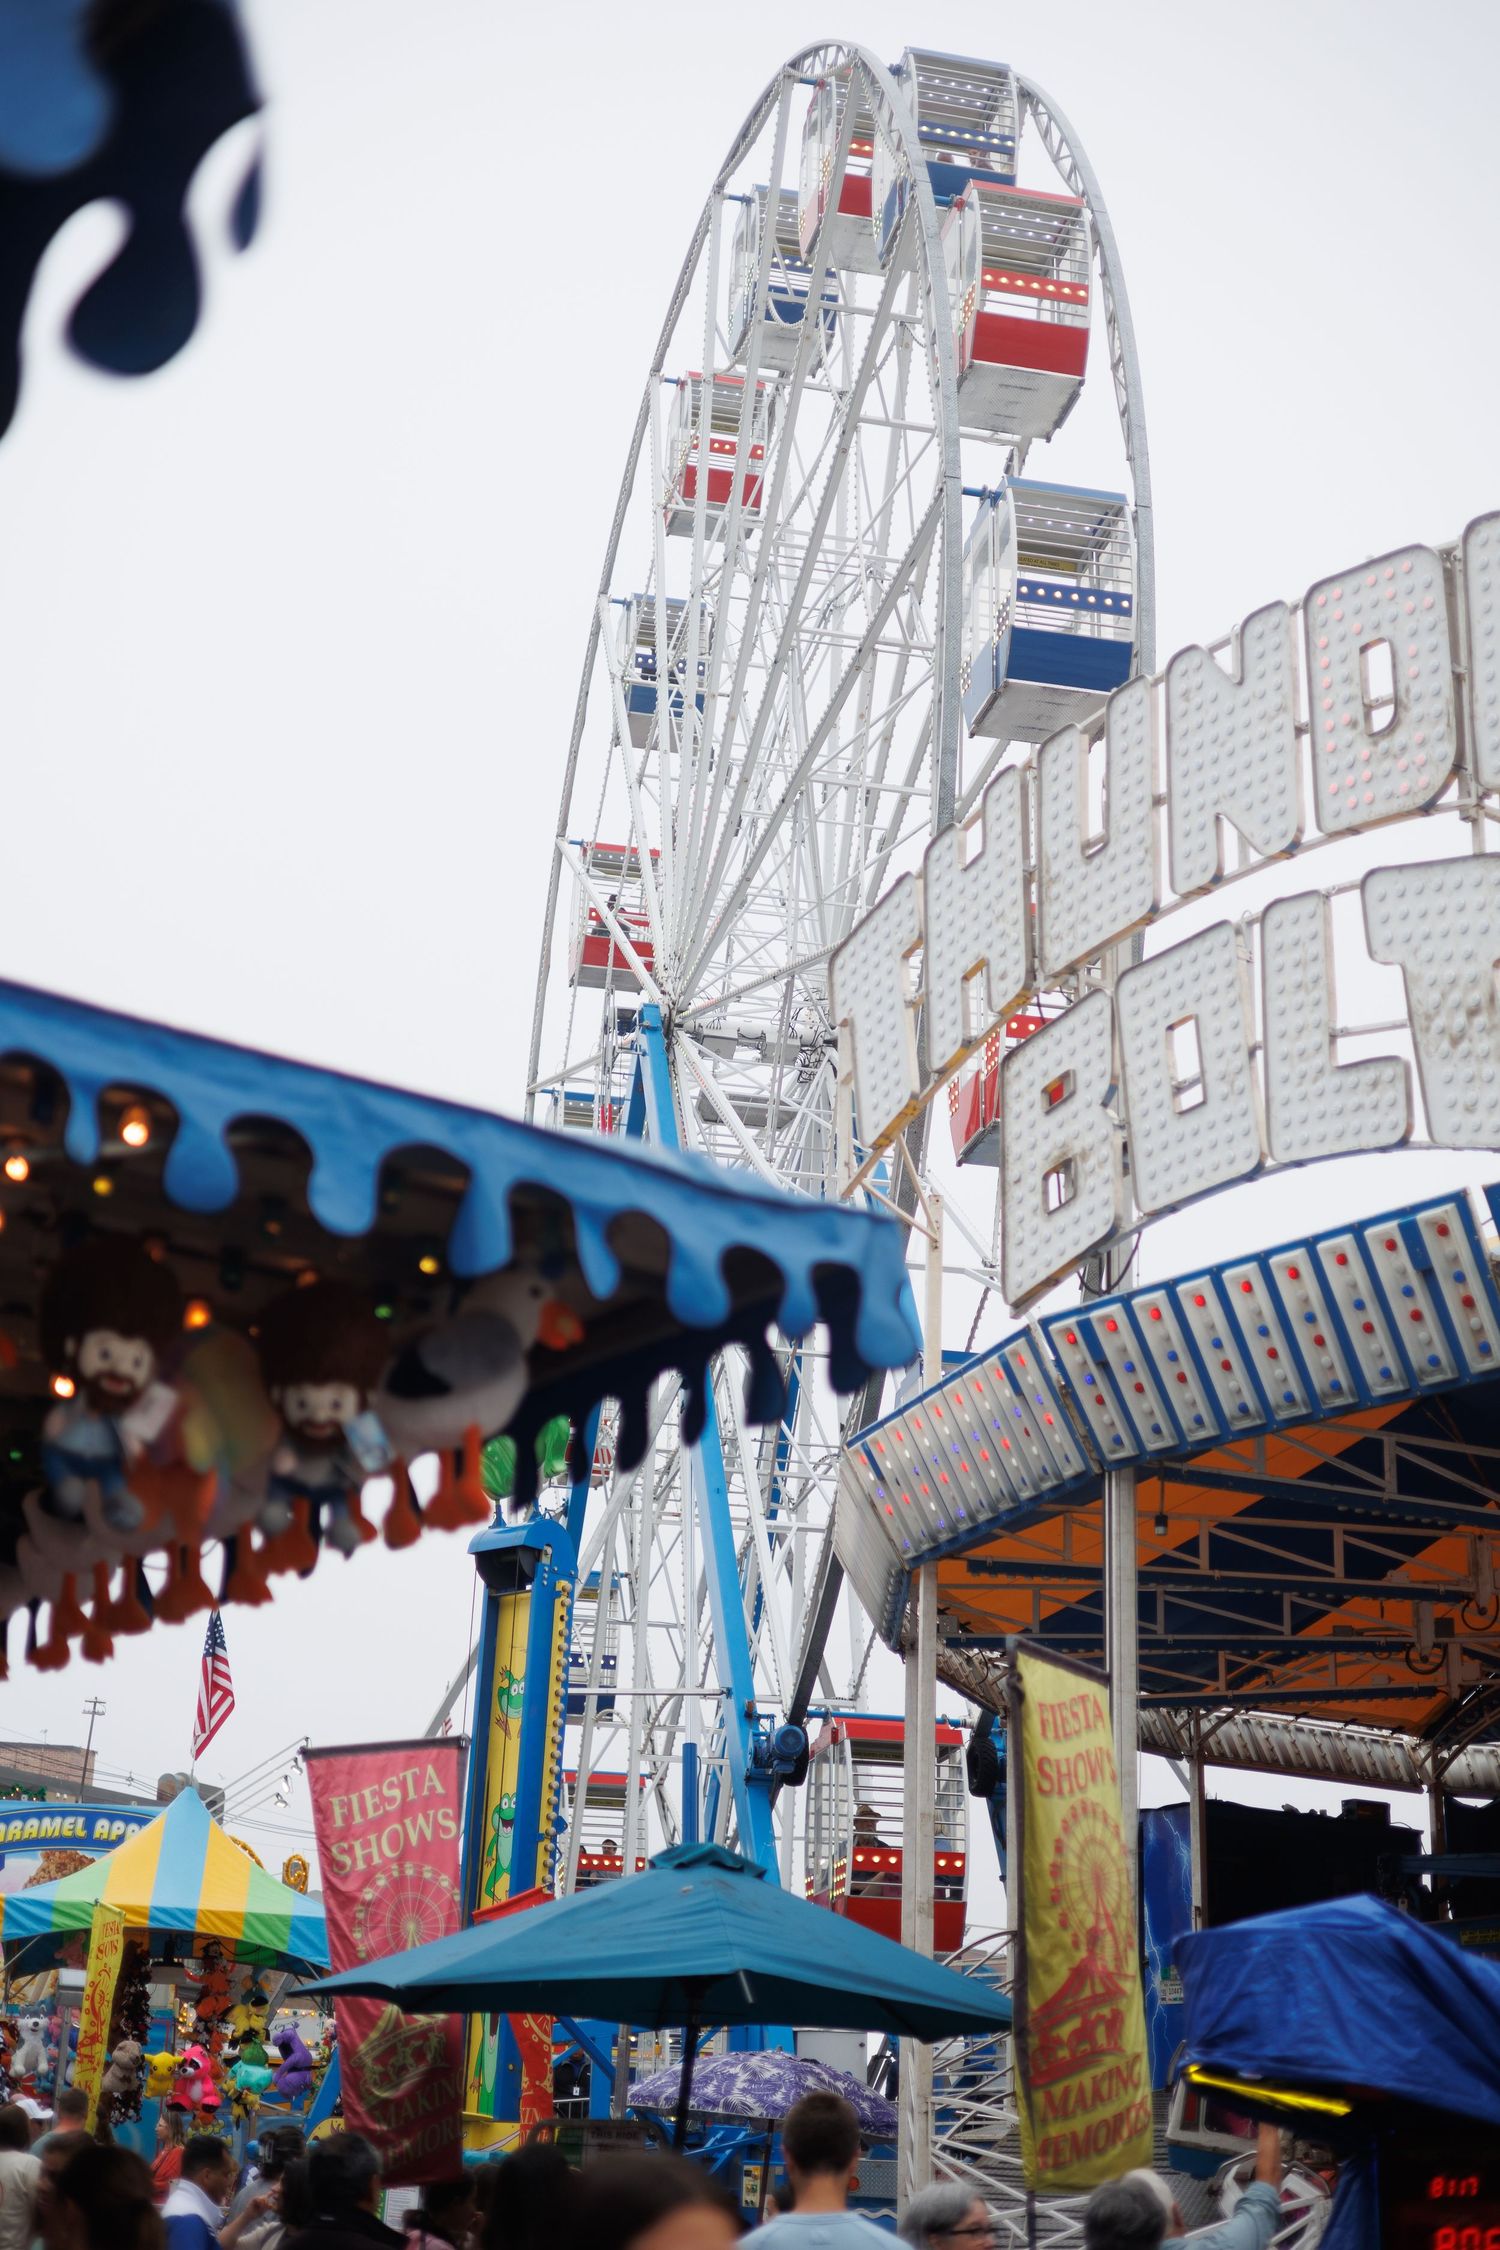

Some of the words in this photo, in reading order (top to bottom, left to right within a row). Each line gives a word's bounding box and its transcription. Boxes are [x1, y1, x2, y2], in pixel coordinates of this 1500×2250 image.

[1036, 1693, 1106, 1743] FIESTA
[329, 1763, 446, 1829] FIESTA
[93, 1817, 143, 1842] APP
[330, 1807, 458, 1875] SHOWS
[1040, 2053, 1142, 2124] MAKING
